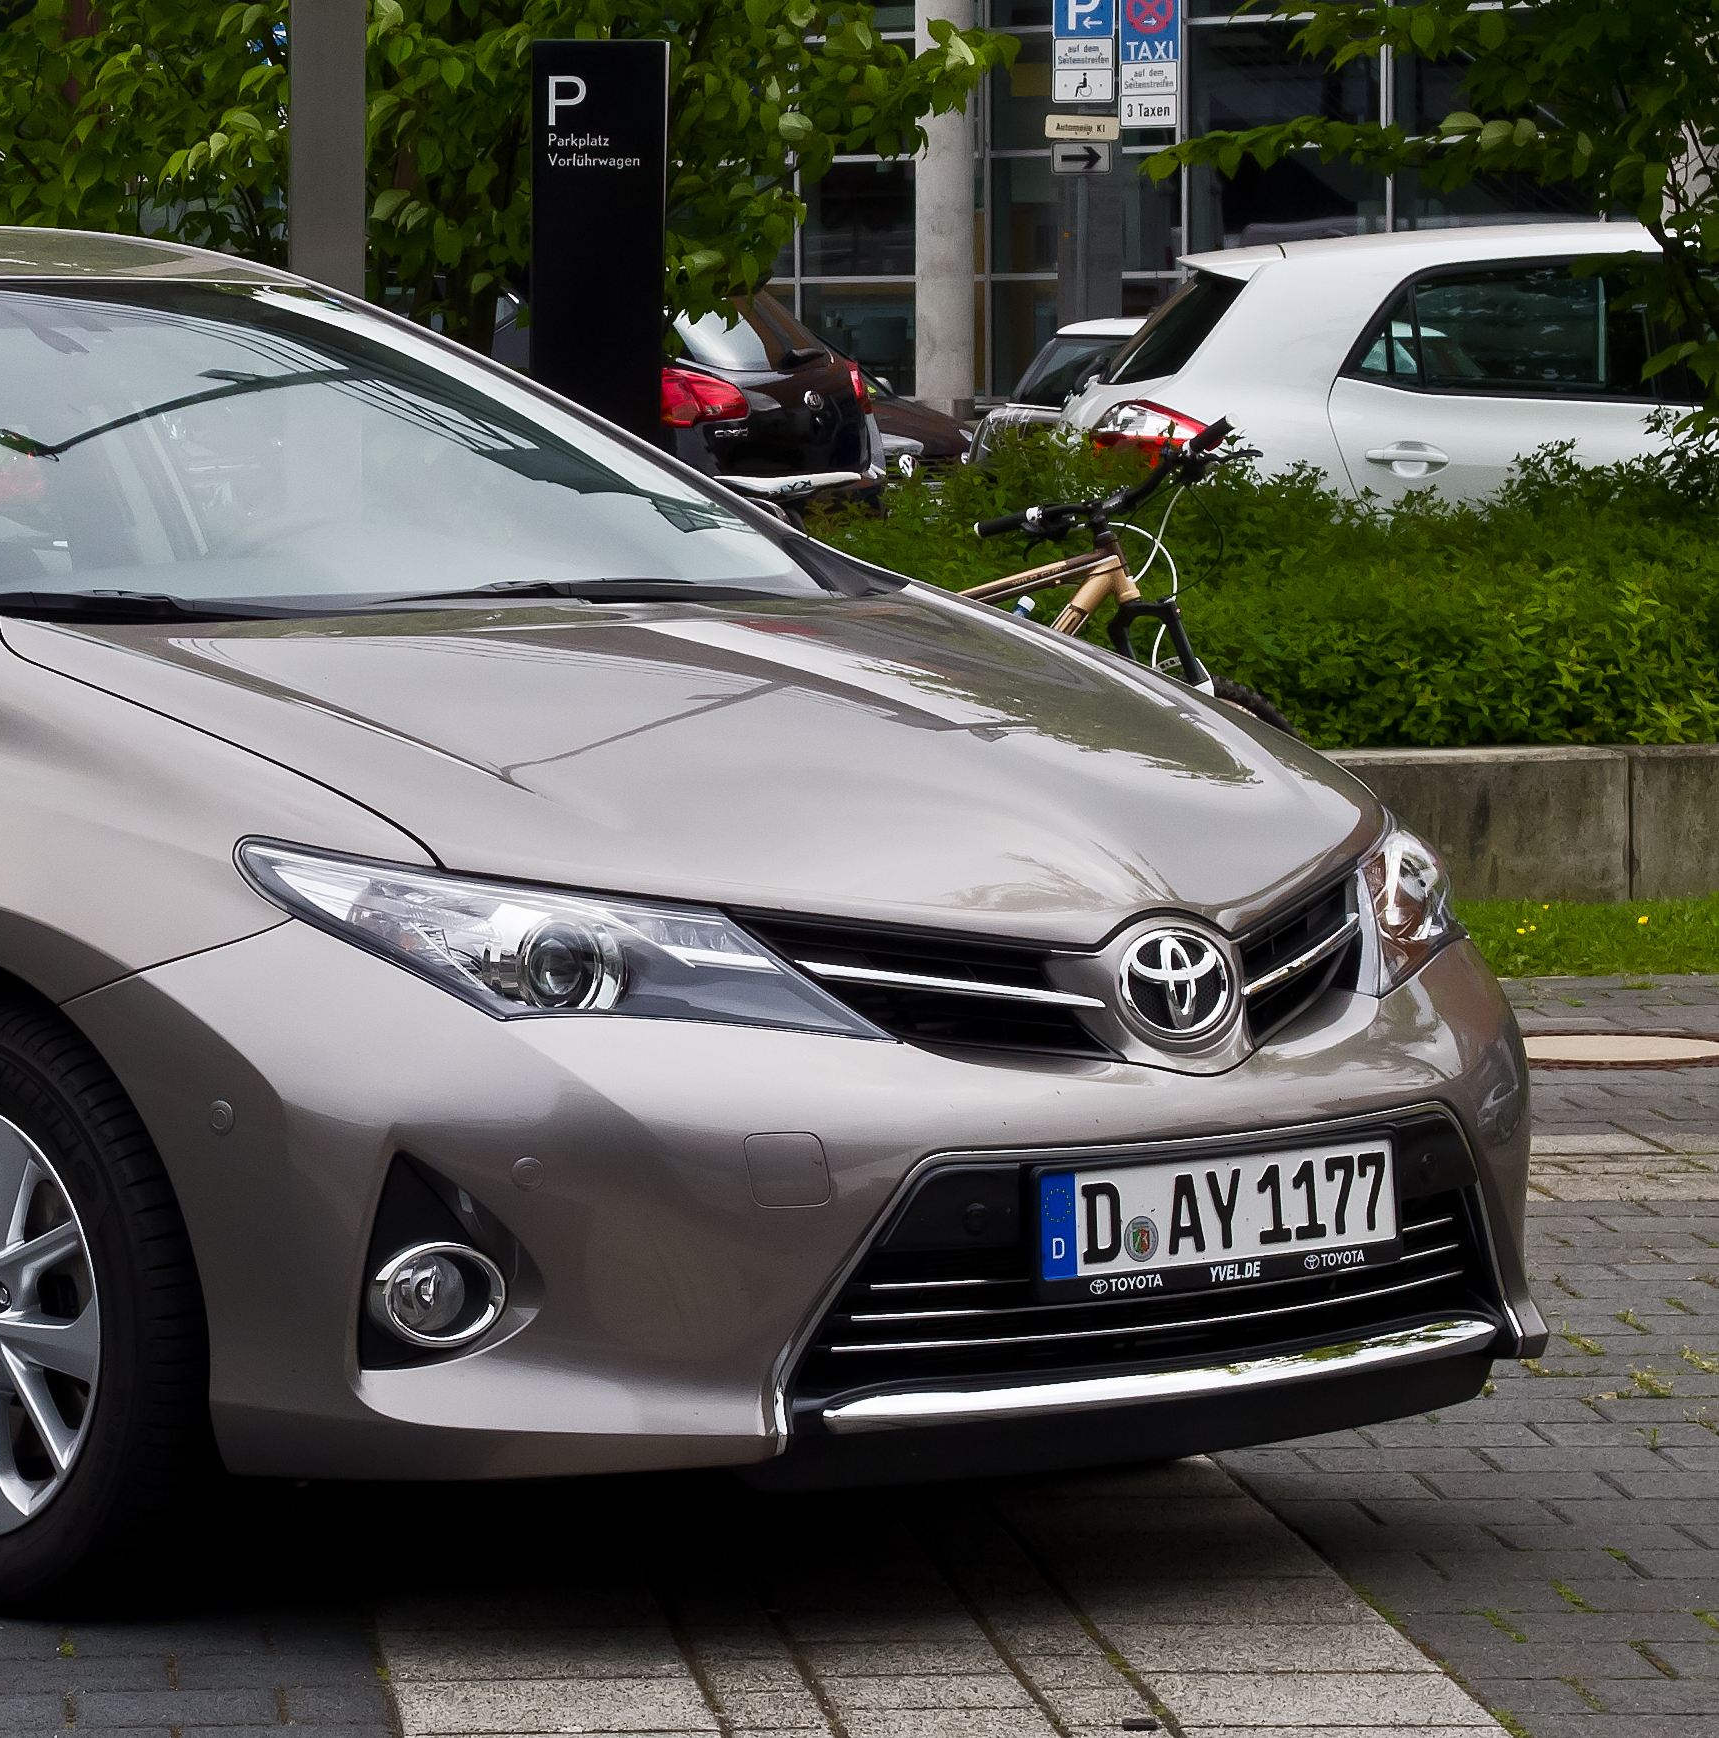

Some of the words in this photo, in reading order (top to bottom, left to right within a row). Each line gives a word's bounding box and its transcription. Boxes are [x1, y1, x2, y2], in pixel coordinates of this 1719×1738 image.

[1068, 44, 1080, 53] auf
[1084, 44, 1100, 53] dem
[1126, 41, 1174, 60] TAXI
[1058, 55, 1110, 64] Seitenstreifen
[1124, 80, 1174, 89] Seitenstreifen
[548, 76, 587, 126] P
[1127, 103, 1133, 117] 3
[1138, 103, 1170, 117] Taxen
[548, 133, 610, 149] Parkplatz
[548, 153, 641, 170] Vorführwagen
[1081, 1182, 1121, 1264] D
[1168, 1168, 1241, 1255] AY
[1257, 1151, 1386, 1245] 1177
[1052, 1237, 1065, 1260] D
[1320, 1250, 1365, 1268] TOYOTA
[1209, 1261, 1261, 1283] YVEL.DE
[1109, 1273, 1163, 1291] TOYOTA
